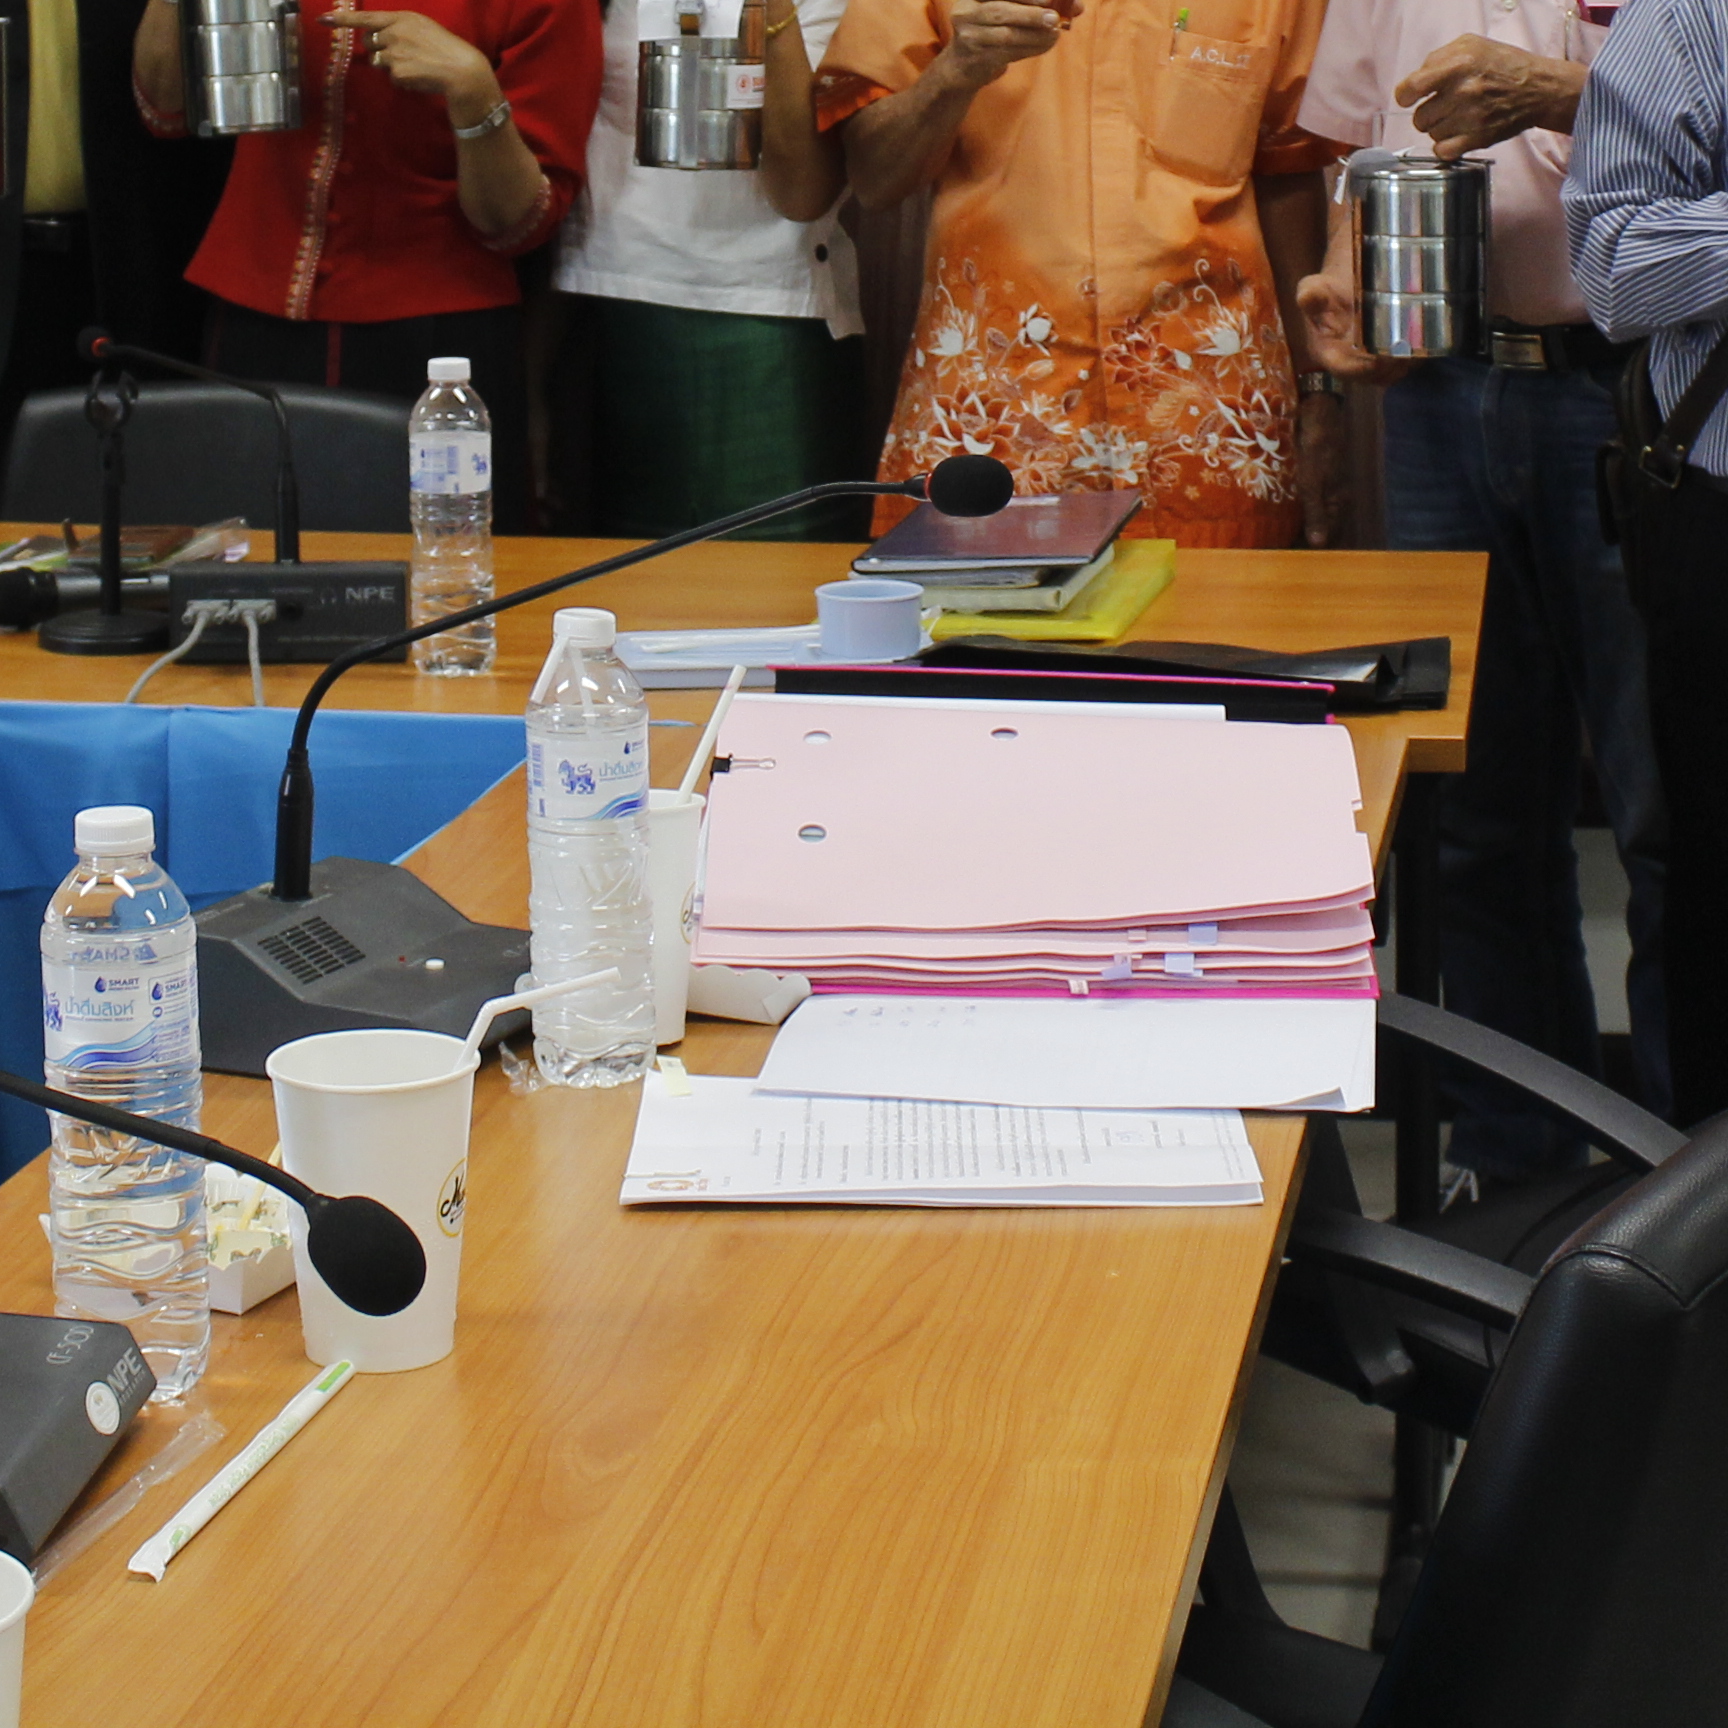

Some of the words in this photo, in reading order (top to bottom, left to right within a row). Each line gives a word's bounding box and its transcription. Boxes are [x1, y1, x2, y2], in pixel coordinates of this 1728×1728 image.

[345, 586, 396, 602] NPE
[109, 977, 140, 987] SMART
[65, 996, 134, 1017] น้ำดื่มสิงห์
[106, 1347, 142, 1392] NPE
